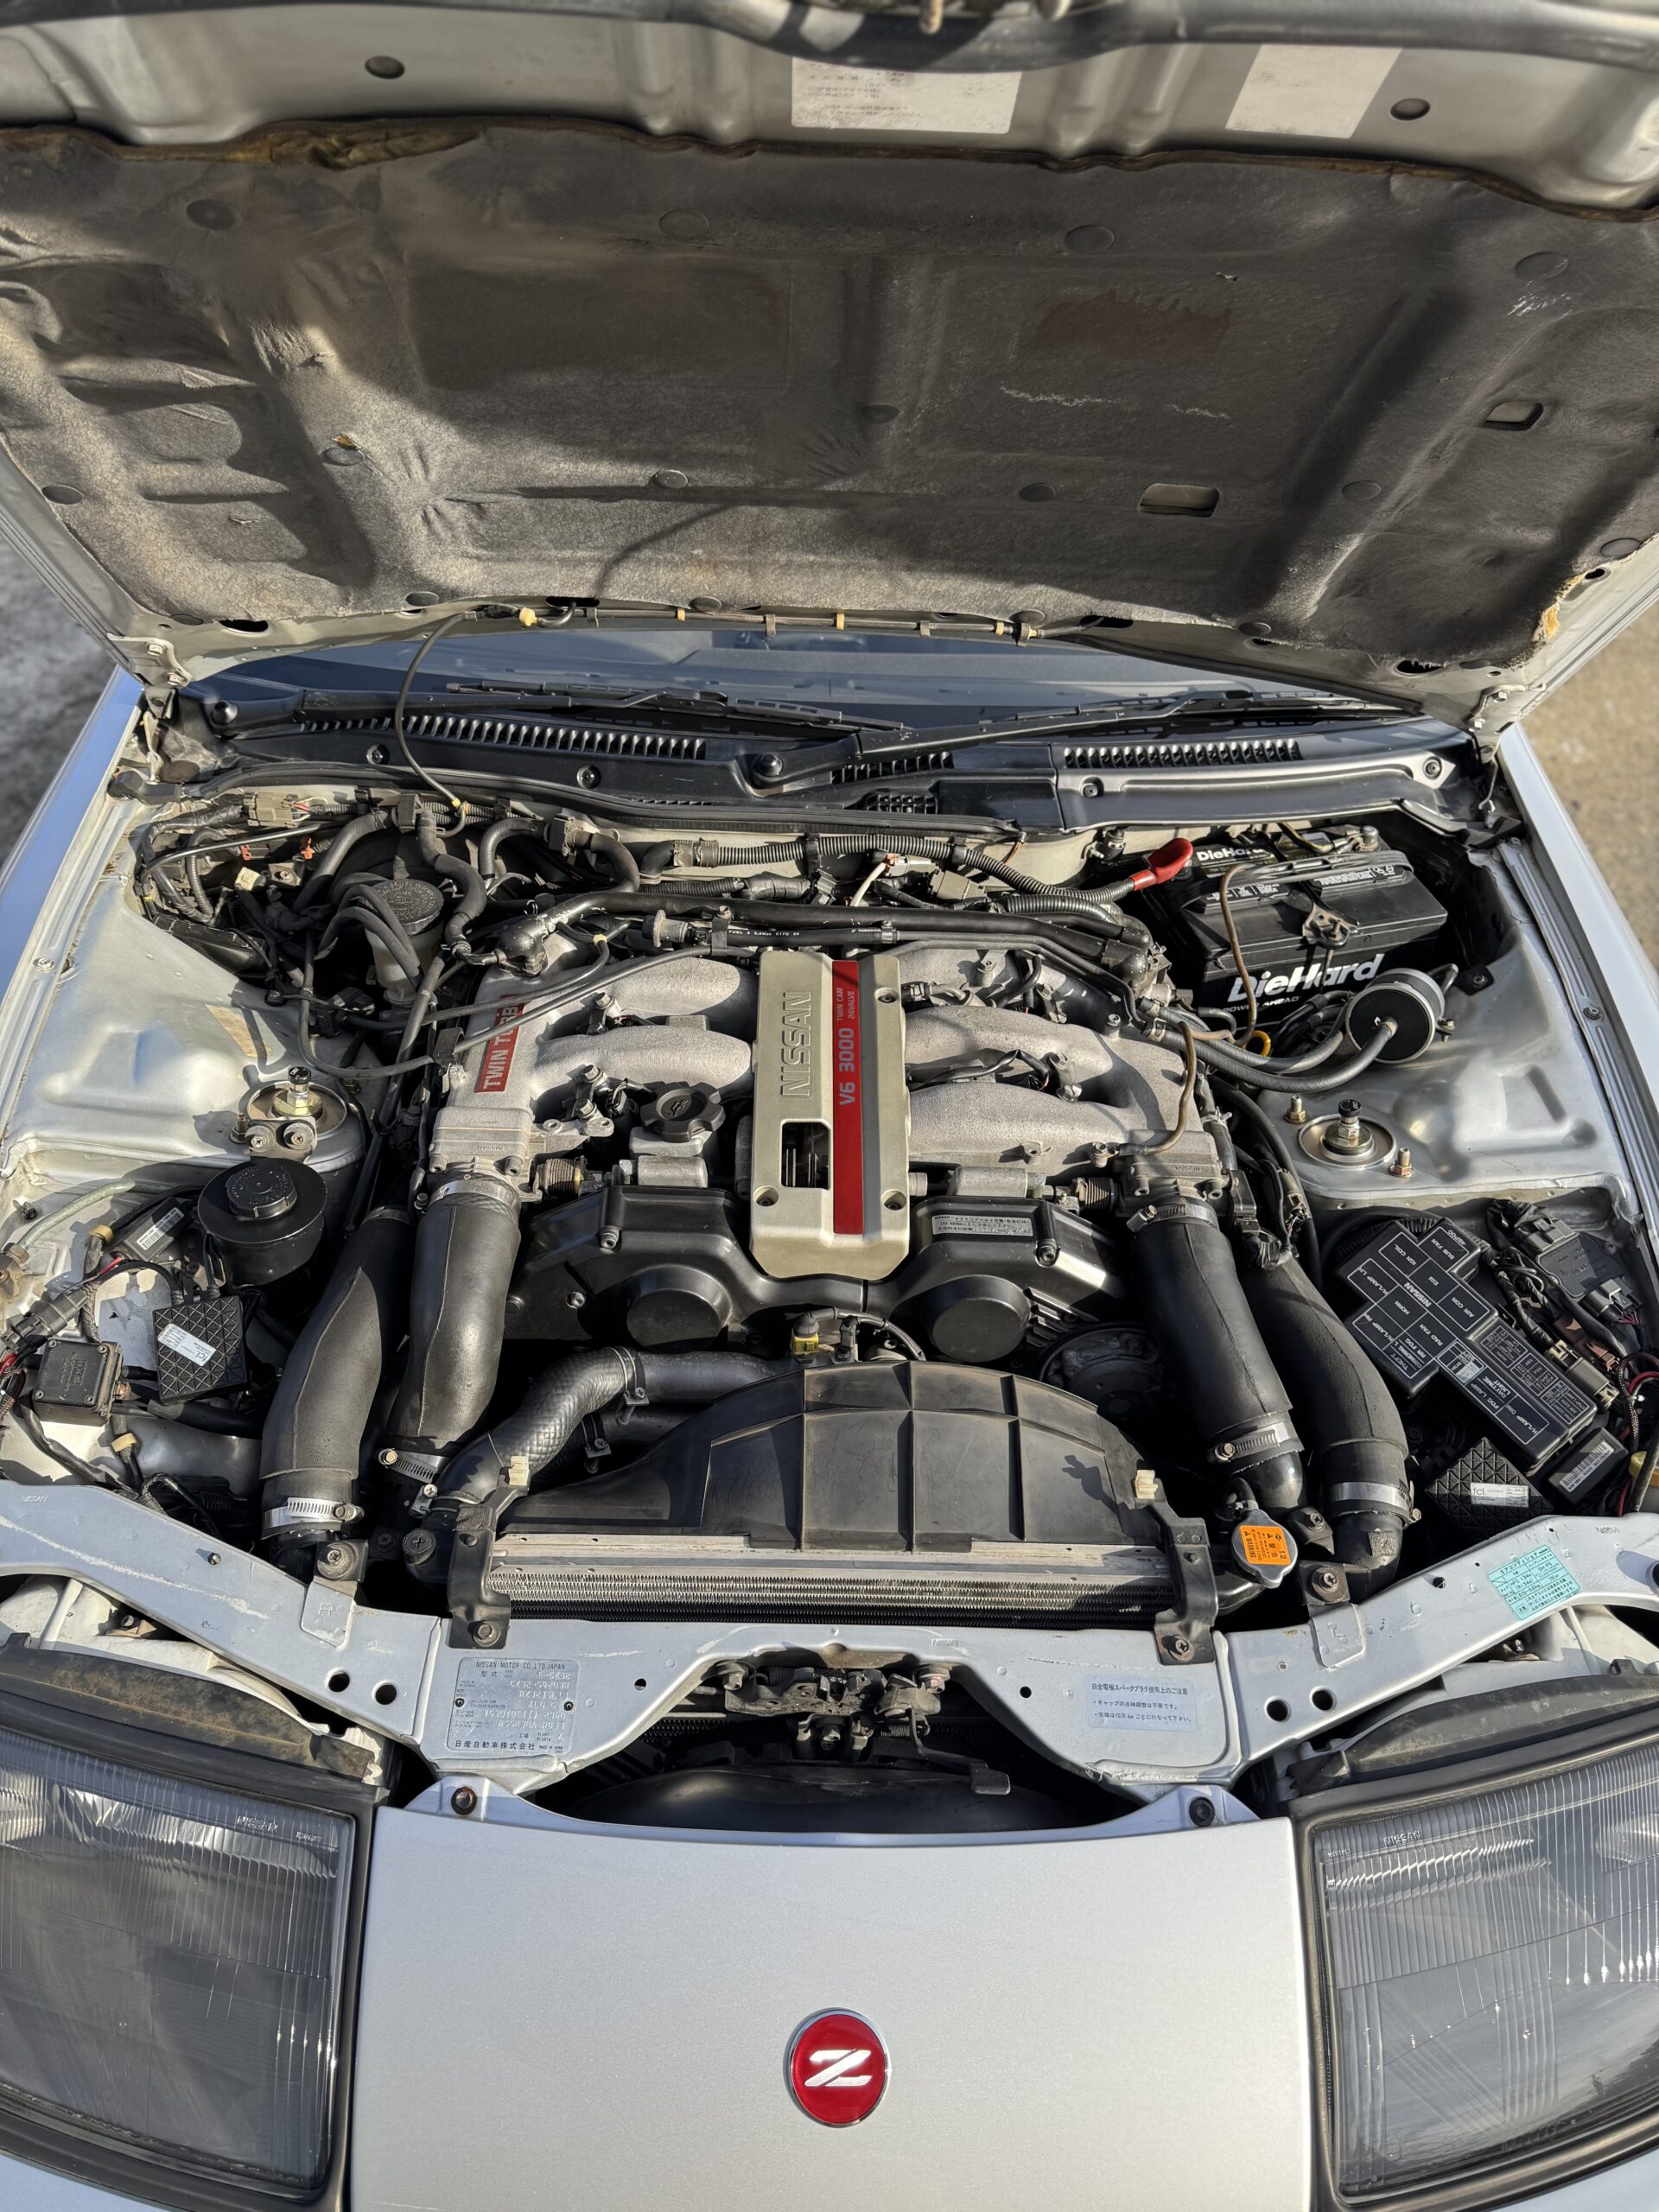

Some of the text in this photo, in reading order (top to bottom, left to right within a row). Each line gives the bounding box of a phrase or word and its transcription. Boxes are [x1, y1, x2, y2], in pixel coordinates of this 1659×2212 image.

[1227, 954, 1383, 1002] DieHard
[780, 992, 811, 1096] NISSAN
[483, 1050, 509, 1089] TWIN
[839, 1028, 855, 1105] V6 3000
[1393, 1243, 1417, 1265] IGN COIL
[1431, 1237, 1455, 1260] SUB FAN
[1357, 1267, 1389, 1294] H/LAMP LH
[1427, 1275, 1439, 1286] EGI
[1403, 1281, 1432, 1307] NISSAN
[1393, 1300, 1410, 1315] HORN
[1451, 1296, 1474, 1318] AIR CON
[1363, 1313, 1394, 1341] H/LAMP RH
[1418, 1323, 1443, 1346] RAD FAN
[1403, 1338, 1417, 1350] FOG
[1389, 1351, 1409, 1370] THEFT
[1470, 1381, 1499, 1408] FOG LAMP
[1482, 1375, 1507, 1398] DAYTIME
[1492, 1378, 1510, 1395] LIGHT
[1516, 1413, 1538, 1434] H/LAMP
[1245, 1537, 1256, 1557] WARNING
[1278, 1550, 1287, 1559] 1.2
[455, 1740, 536, 1750] 日産自動車株式会社
[1382, 1830, 1421, 1847] NISSAN
[804, 2049, 872, 2087] Z
